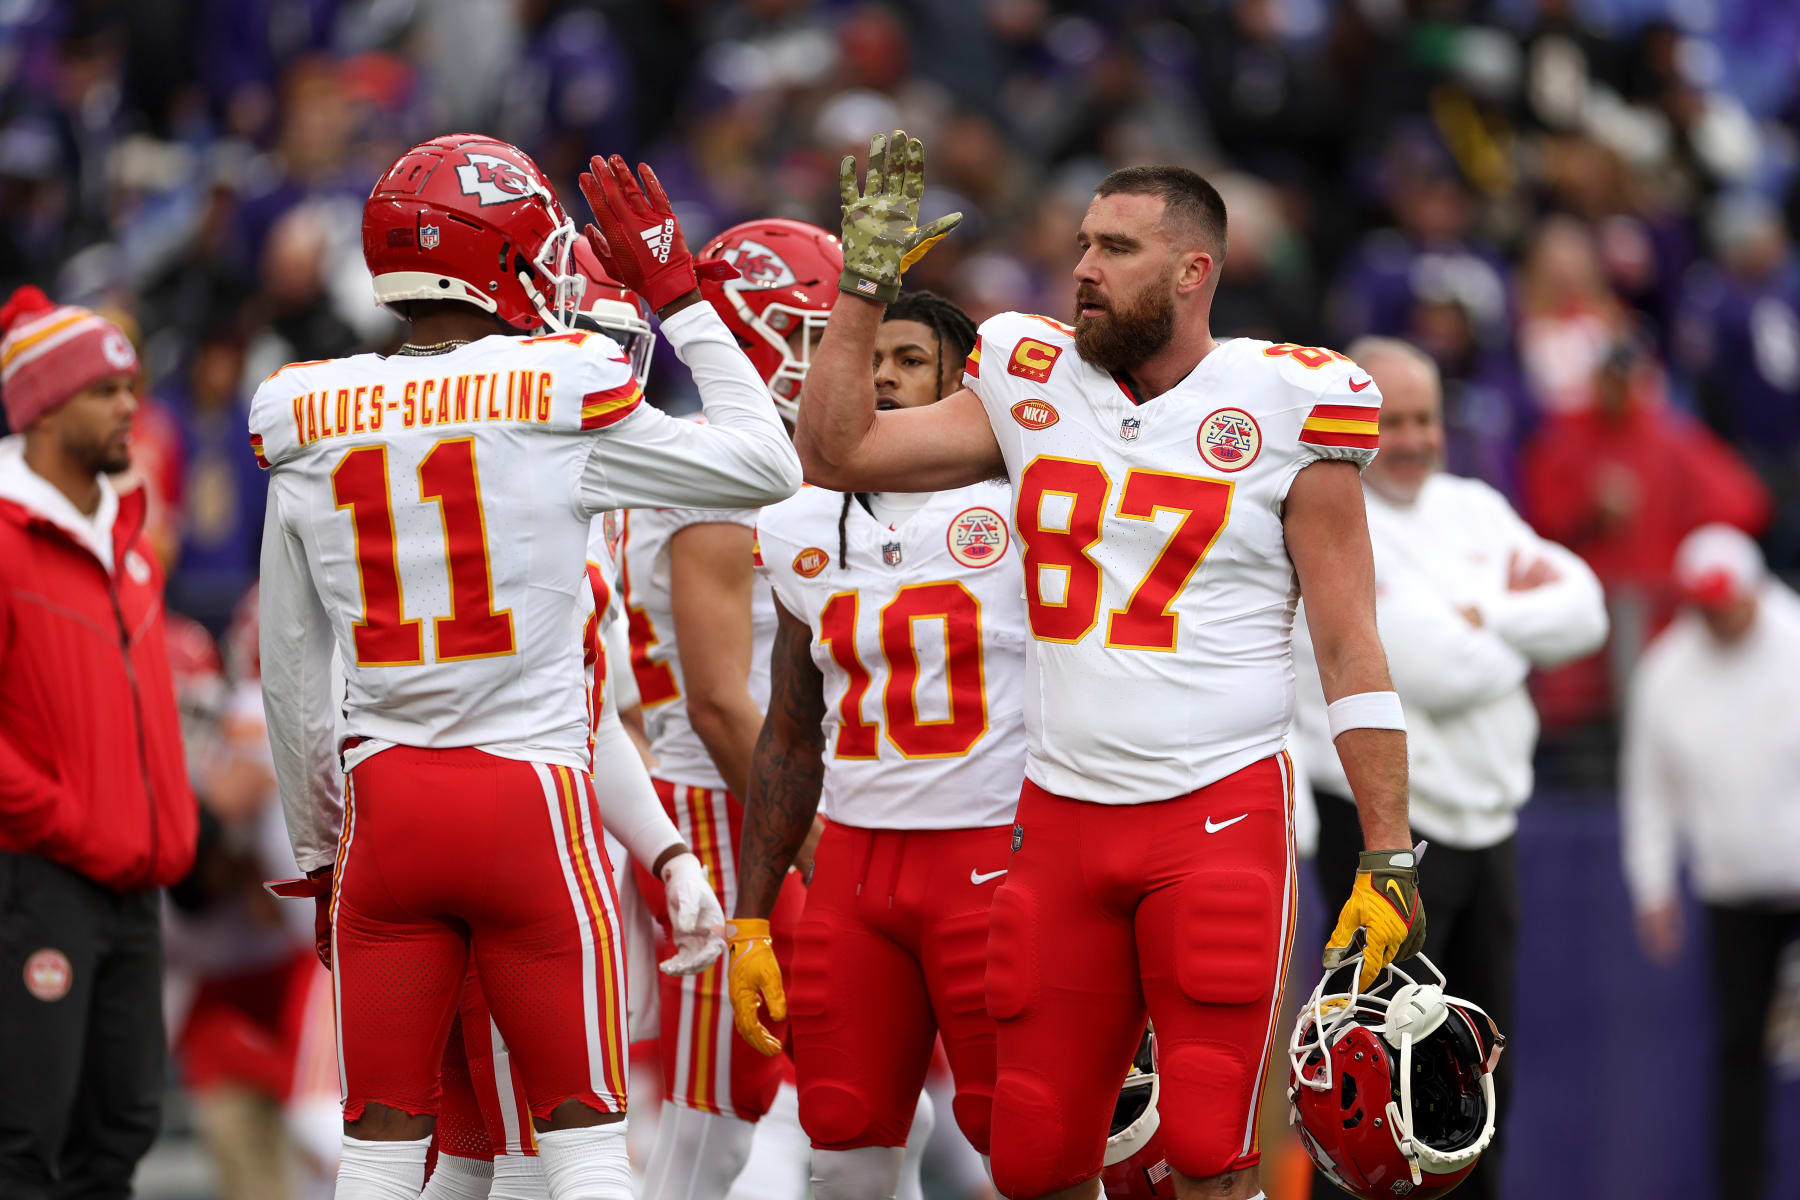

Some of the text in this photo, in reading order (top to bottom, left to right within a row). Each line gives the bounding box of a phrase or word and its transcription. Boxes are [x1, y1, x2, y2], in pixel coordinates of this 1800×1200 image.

[474, 162, 528, 195] KC
[422, 235, 438, 246] NFL
[658, 218, 675, 264] adidas
[1015, 340, 1057, 371] C
[293, 369, 554, 449] VALDES-SCANTLING
[1022, 405, 1049, 424] NKH
[1121, 426, 1139, 439] NFL
[1206, 415, 1251, 452] A
[956, 515, 1000, 546] A
[331, 435, 517, 668] 11
[800, 553, 820, 571] NKH
[1014, 453, 1236, 652] 87
[818, 579, 990, 761] 10
